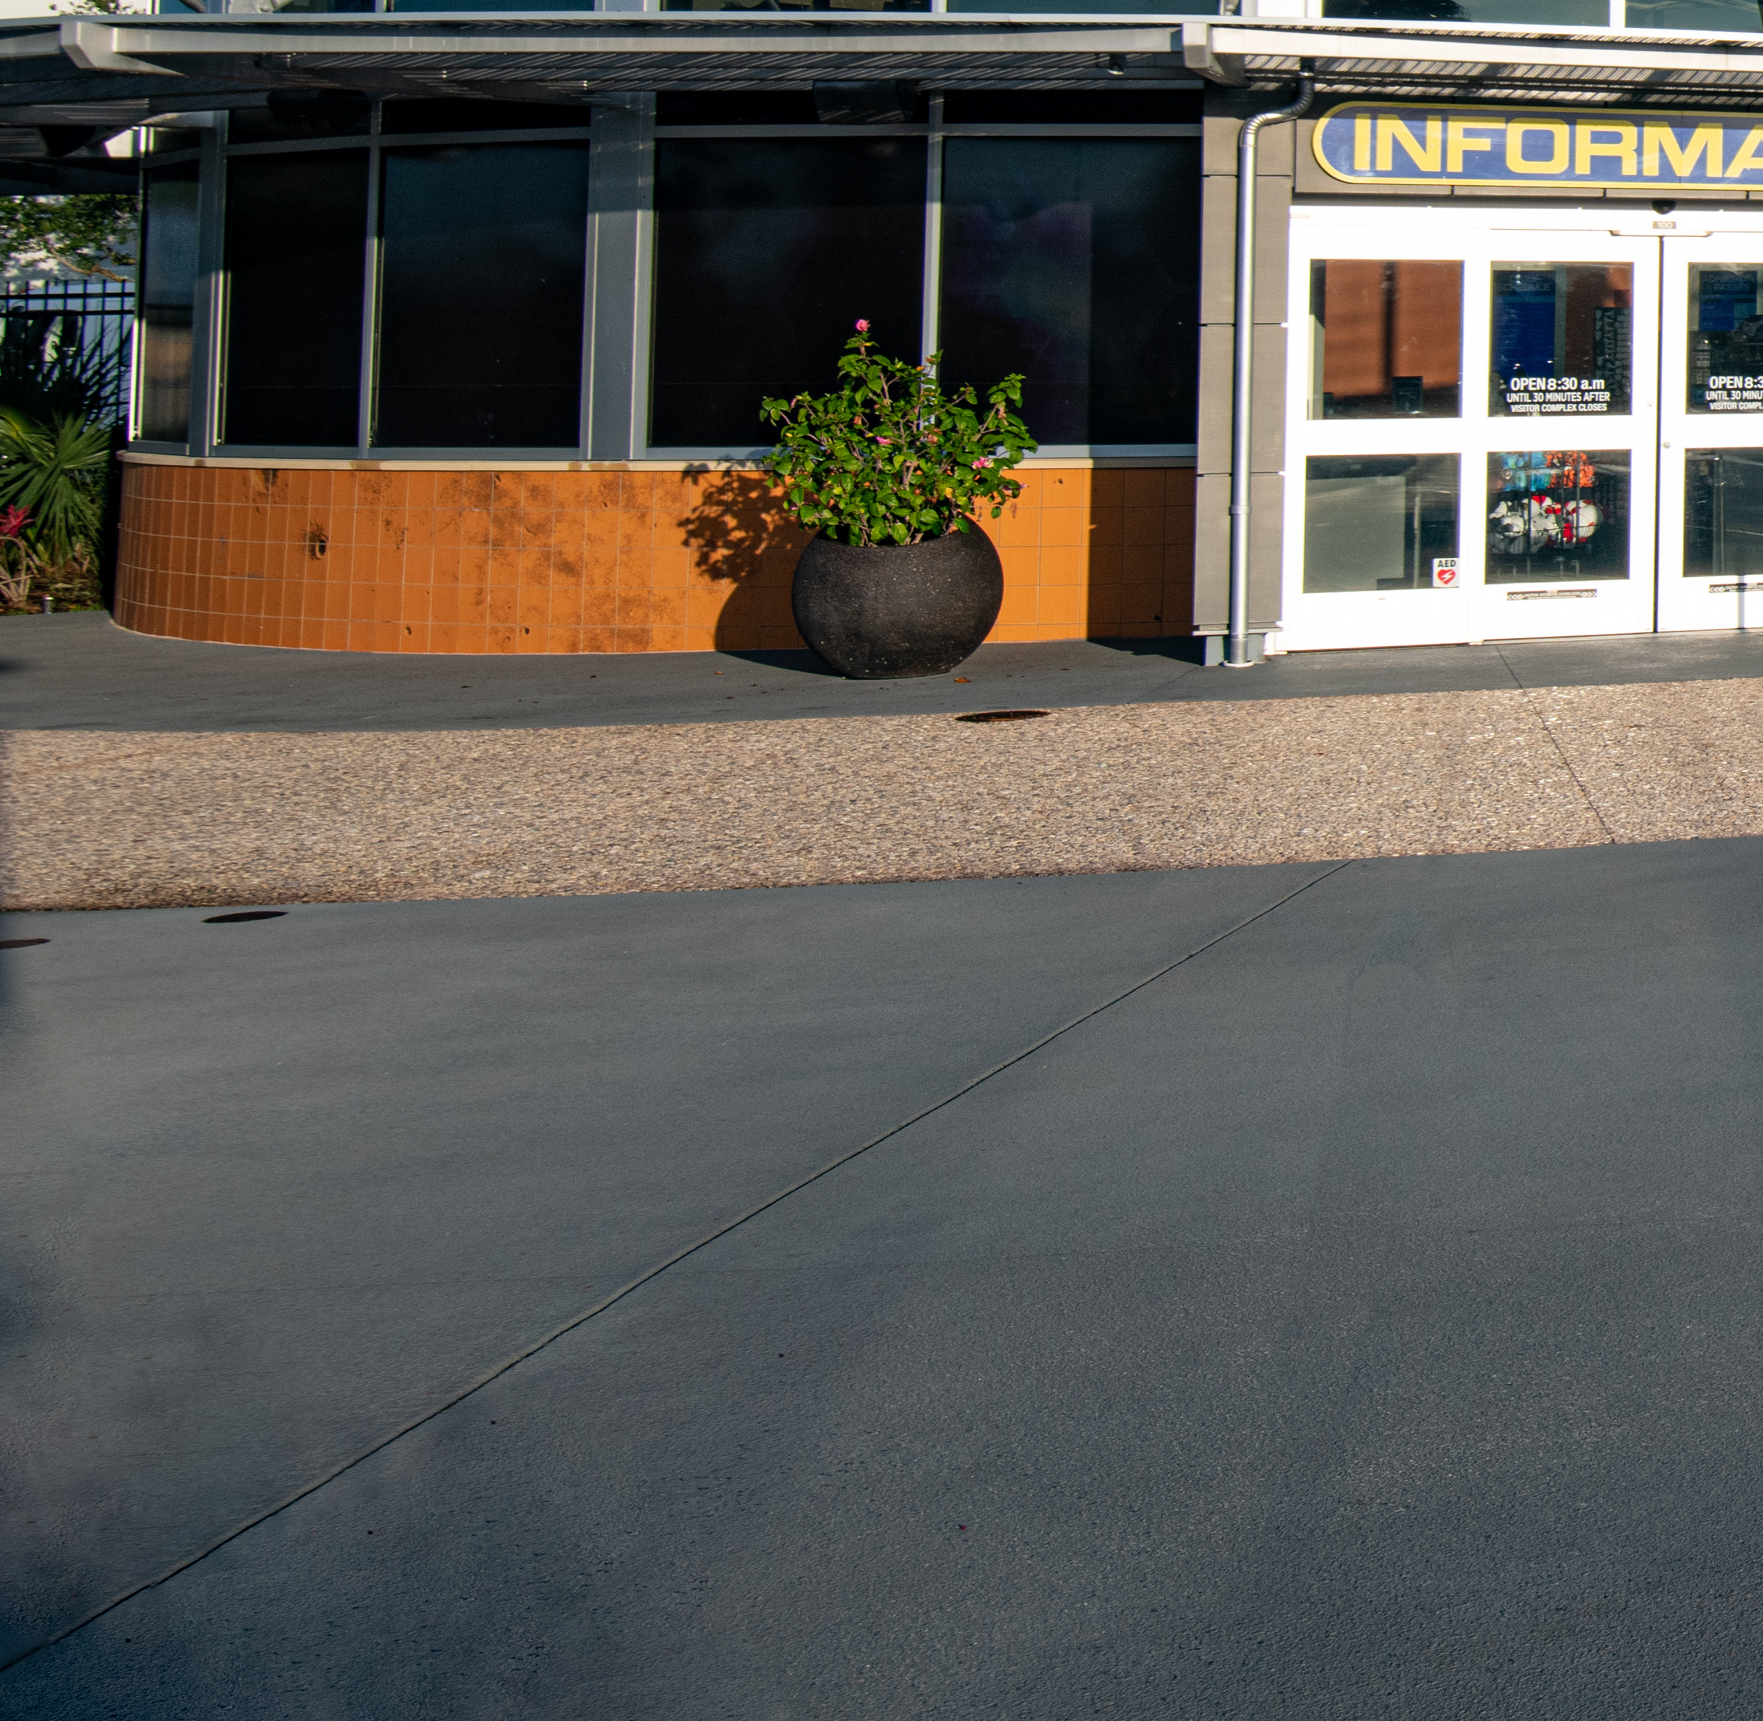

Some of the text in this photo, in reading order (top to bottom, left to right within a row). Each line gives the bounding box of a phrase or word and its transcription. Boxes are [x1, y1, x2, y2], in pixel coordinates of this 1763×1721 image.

[1656, 221, 1674, 229] 100
[1510, 377, 1605, 391] OPEN 8:30 a.m
[1709, 376, 1743, 389] OPEN
[1506, 391, 1611, 403] UNTIL 30 MINUTES AFTER
[1705, 390, 1730, 400] UNTIL
[1730, 390, 1741, 400] 30
[1510, 403, 1608, 413] VISITOR COMPLEX CLOSES
[1709, 402, 1738, 410] VISITOR
[1437, 559, 1457, 568] AED
